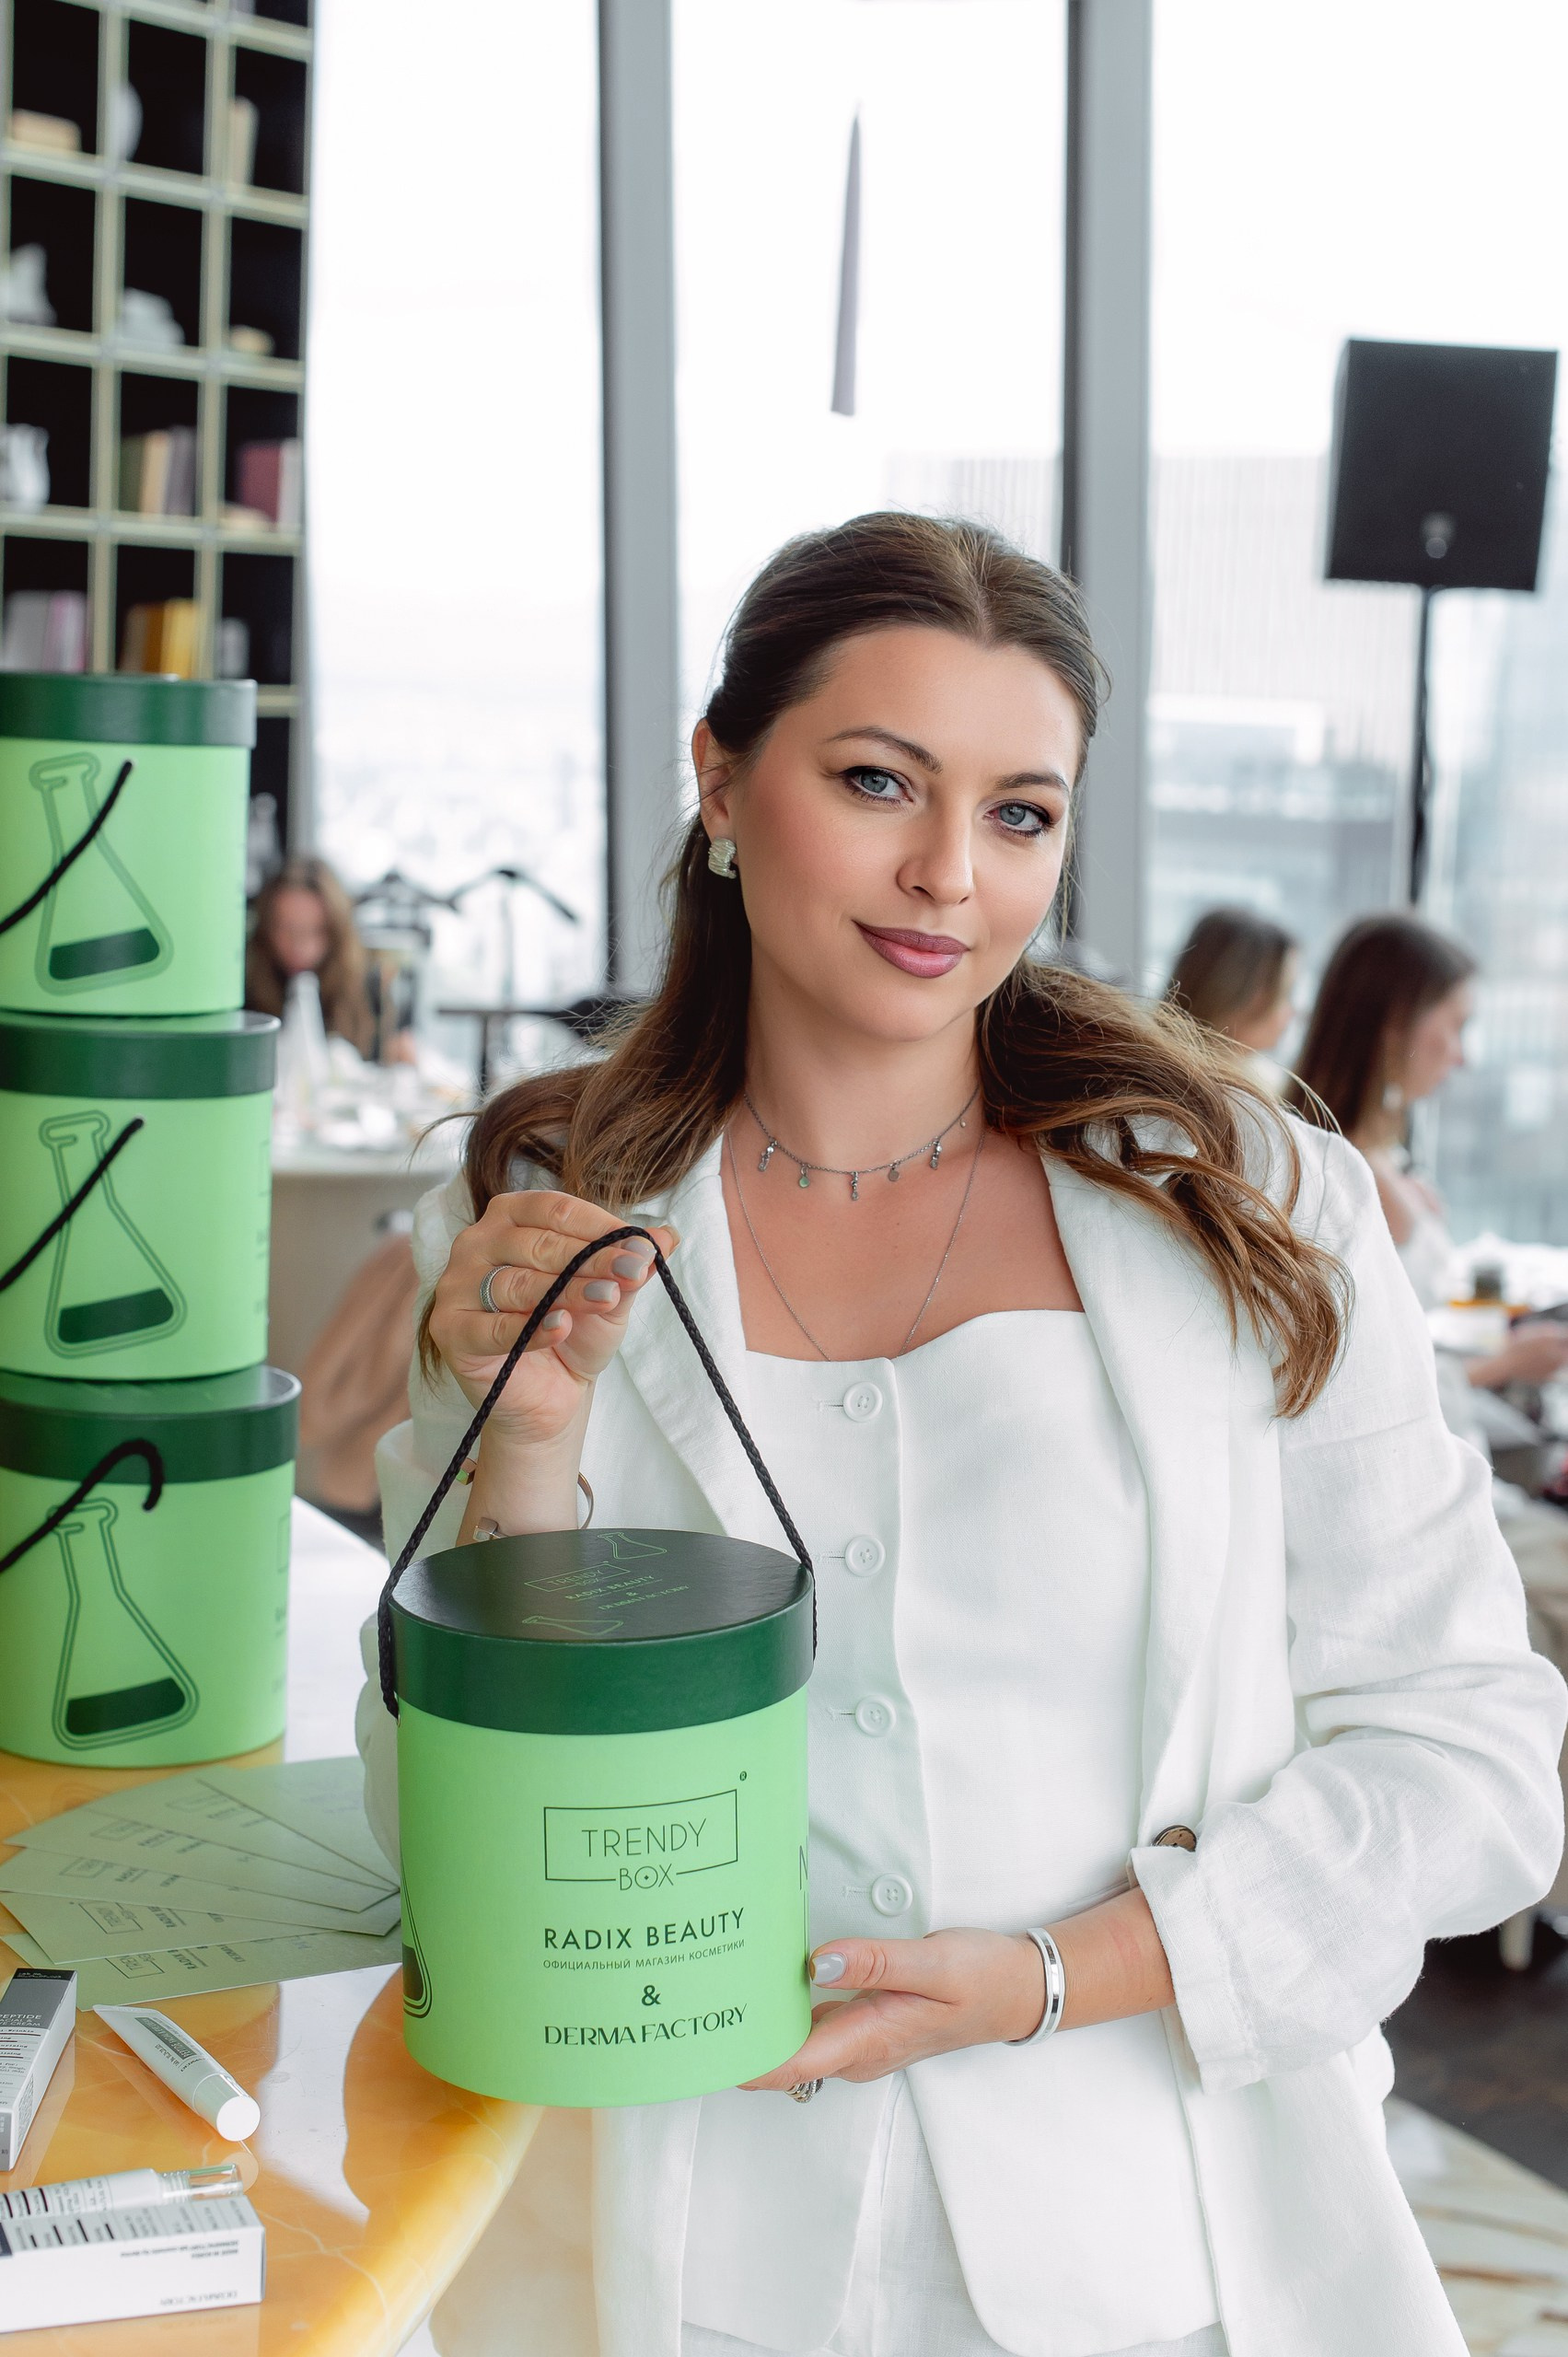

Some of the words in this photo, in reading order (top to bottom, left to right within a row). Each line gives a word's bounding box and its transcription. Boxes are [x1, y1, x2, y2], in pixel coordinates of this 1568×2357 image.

[564, 1587, 607, 1600] RADIX
[606, 1574, 655, 1590] BEAUTY
[582, 1817, 707, 1858] TRENDY
[619, 1864, 674, 1891] BOX
[544, 1928, 633, 1950] RADIX
[646, 1907, 745, 1947] BEAUTY
[542, 1958, 631, 1971] ОФИЦИАЛЬНЫЙ
[635, 1953, 685, 1968] МАГАЗИН
[689, 1939, 745, 1961] КОСМЕТИКИ
[641, 1984, 662, 2006] &
[544, 2025, 636, 2046] DERMA
[642, 2003, 748, 2043] FACTORY
